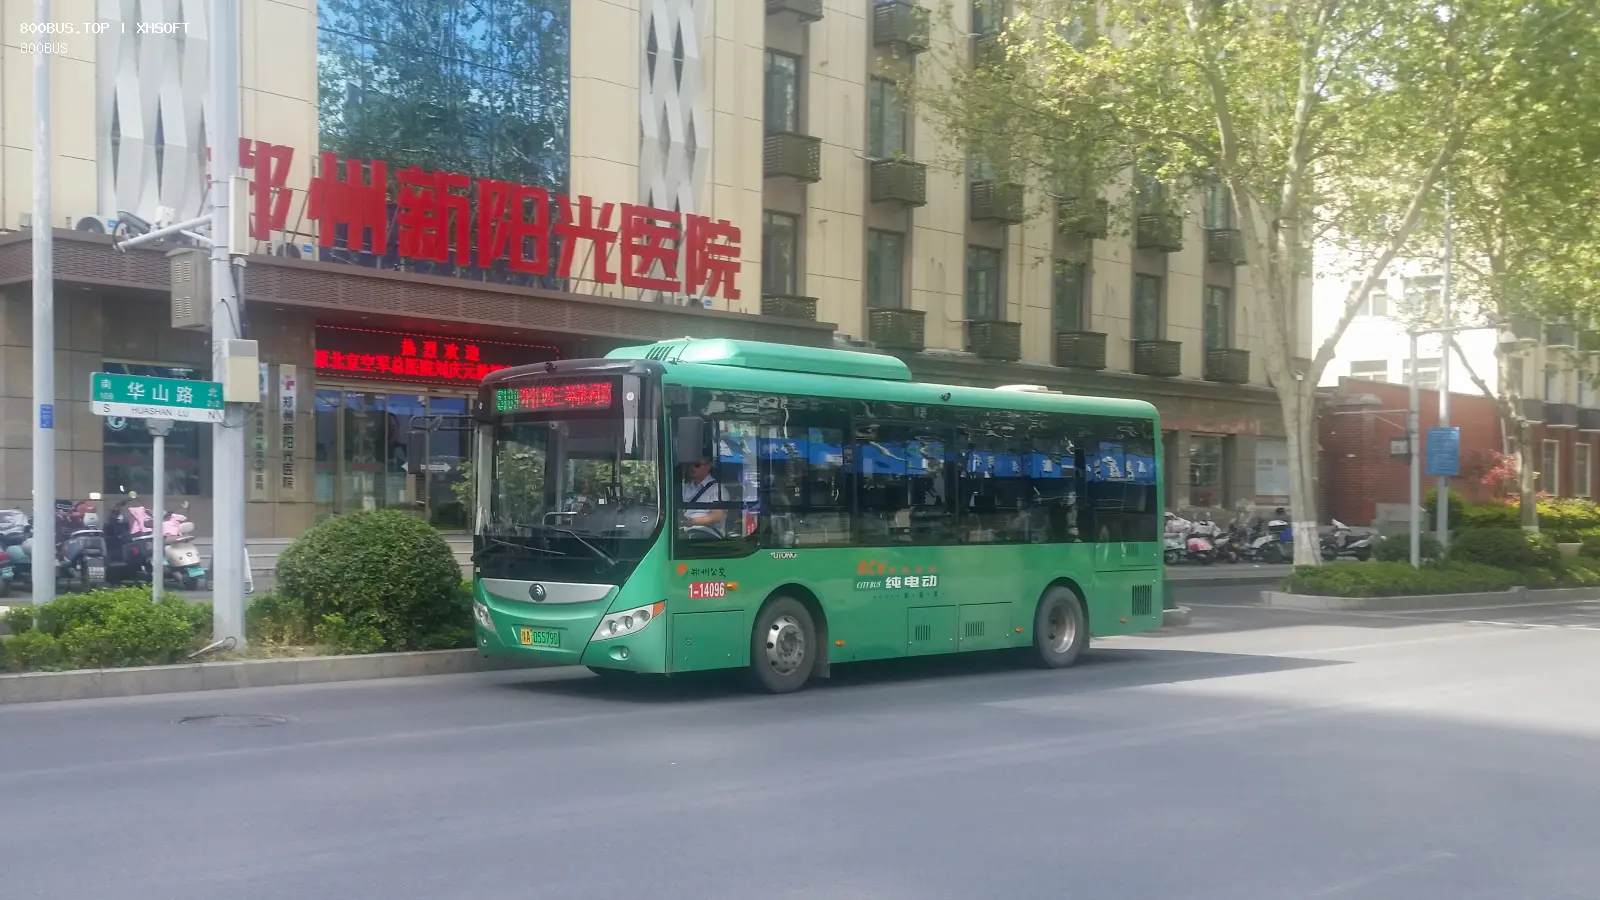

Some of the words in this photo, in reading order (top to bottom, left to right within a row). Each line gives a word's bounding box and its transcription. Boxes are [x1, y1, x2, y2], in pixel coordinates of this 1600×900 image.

[206, 137, 742, 300] 郑州新阳光医院
[100, 378, 112, 390] 南
[126, 381, 194, 404] 华山路
[207, 387, 219, 398] 北
[103, 403, 111, 413] S
[131, 407, 173, 417] HUASHAN
[208, 410, 216, 420] N
[769, 551, 797, 560] YUTONG
[885, 575, 938, 589] 纯电动
[688, 582, 725, 598] 1-14096
